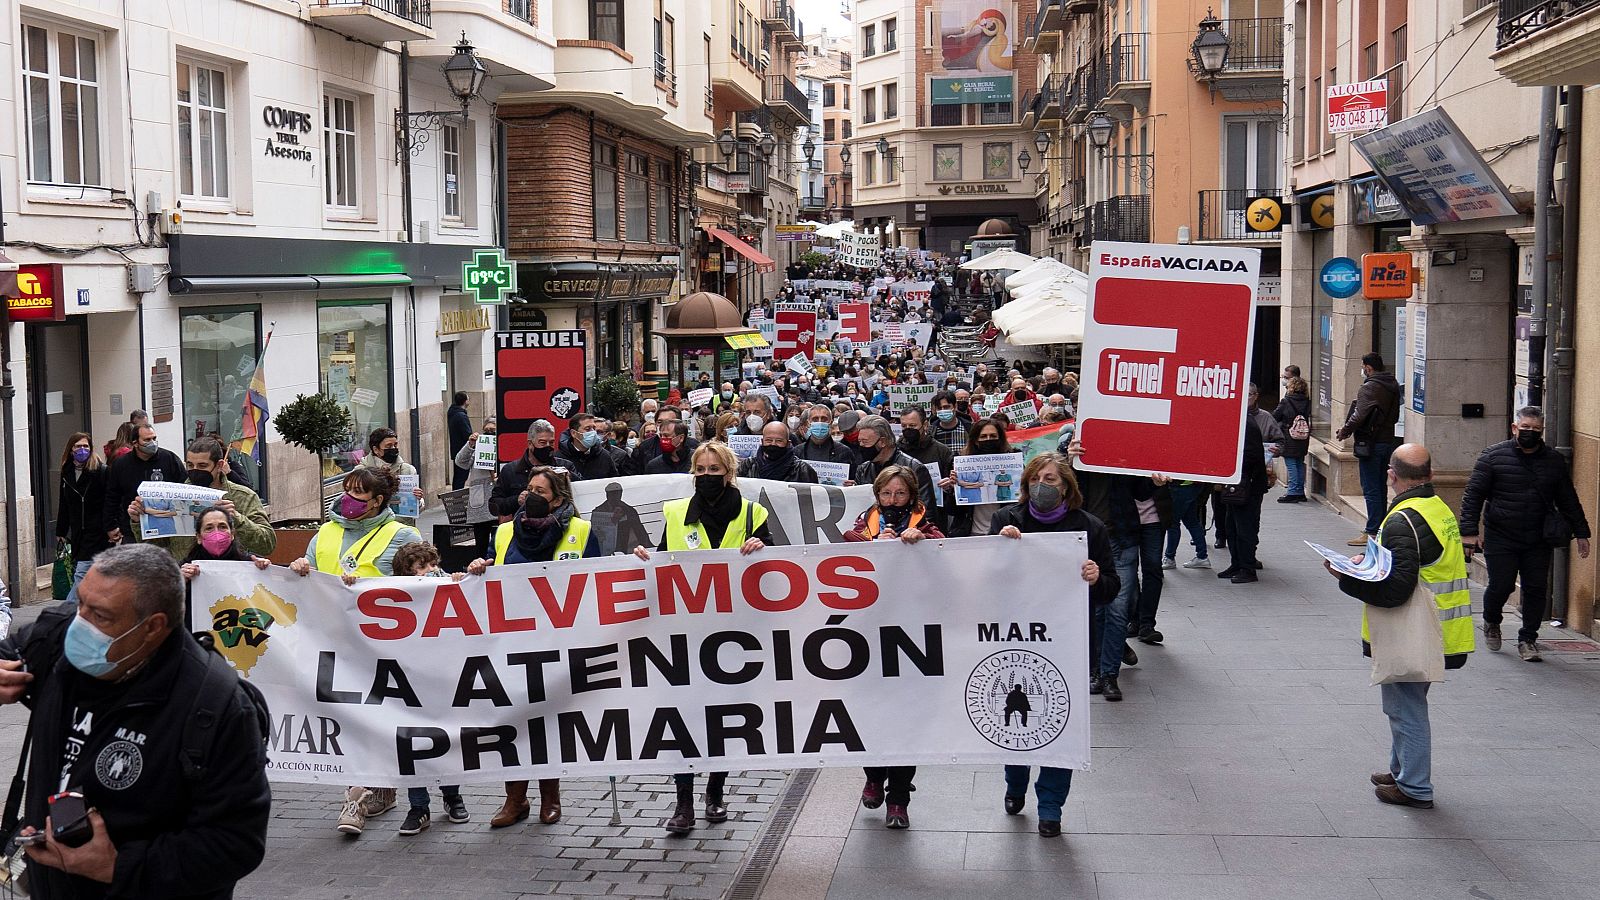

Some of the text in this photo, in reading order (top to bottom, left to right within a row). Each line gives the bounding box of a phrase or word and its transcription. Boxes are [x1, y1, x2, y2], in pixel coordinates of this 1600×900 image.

[1330, 81, 1385, 96] ALQUILA
[1329, 108, 1386, 128] 978 048 117
[264, 138, 312, 162] Asesoría
[842, 233, 878, 245] SER POCOS
[841, 243, 878, 257] NO RESTA
[840, 254, 878, 266] DERECHOS
[1323, 274, 1359, 282] DIGI
[1370, 262, 1406, 281] Ria
[8, 298, 52, 306] TABACOS
[80, 291, 89, 303] 10
[442, 308, 489, 332] FARMACIA
[497, 332, 584, 347] TERUEL
[1108, 354, 1238, 400] Teruel existe!
[1012, 401, 1032, 411] SALUD
[1010, 414, 1036, 424] RIMERO
[356, 556, 880, 640] SALVEMOS
[977, 622, 1052, 642] M.A.R.
[316, 615, 945, 708] LA ATENCIÓN
[968, 652, 1068, 748] MOVIMIENTO DE ACCIÓN RURAL
[265, 714, 344, 755] MAR
[395, 699, 866, 776] PRIMARIA
[276, 760, 311, 772] ACCIÓN
[313, 763, 344, 773] RURAL
